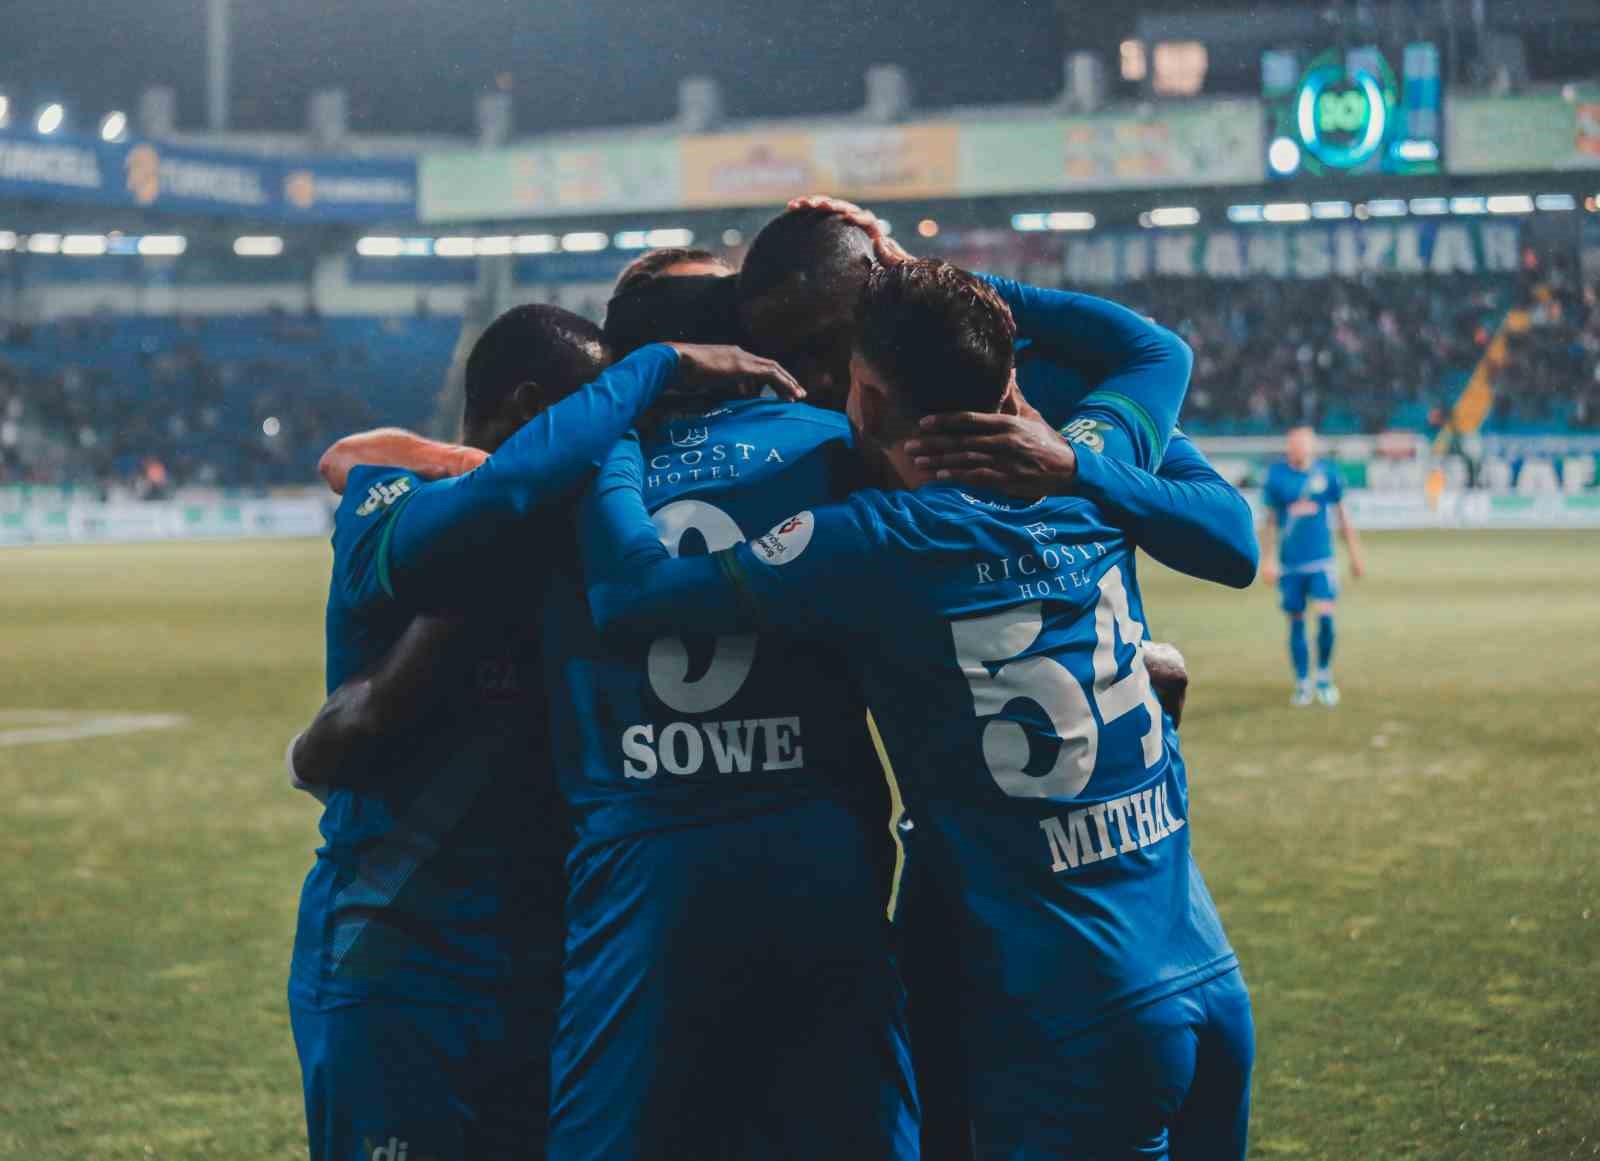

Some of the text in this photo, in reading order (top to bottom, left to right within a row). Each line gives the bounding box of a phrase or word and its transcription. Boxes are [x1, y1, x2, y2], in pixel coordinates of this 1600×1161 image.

[648, 464, 740, 488] HOTEL
[975, 540, 1107, 584] RICOSTA
[1018, 568, 1091, 600] HOTEL
[950, 563, 1163, 800] 54
[621, 716, 804, 780] SOWE
